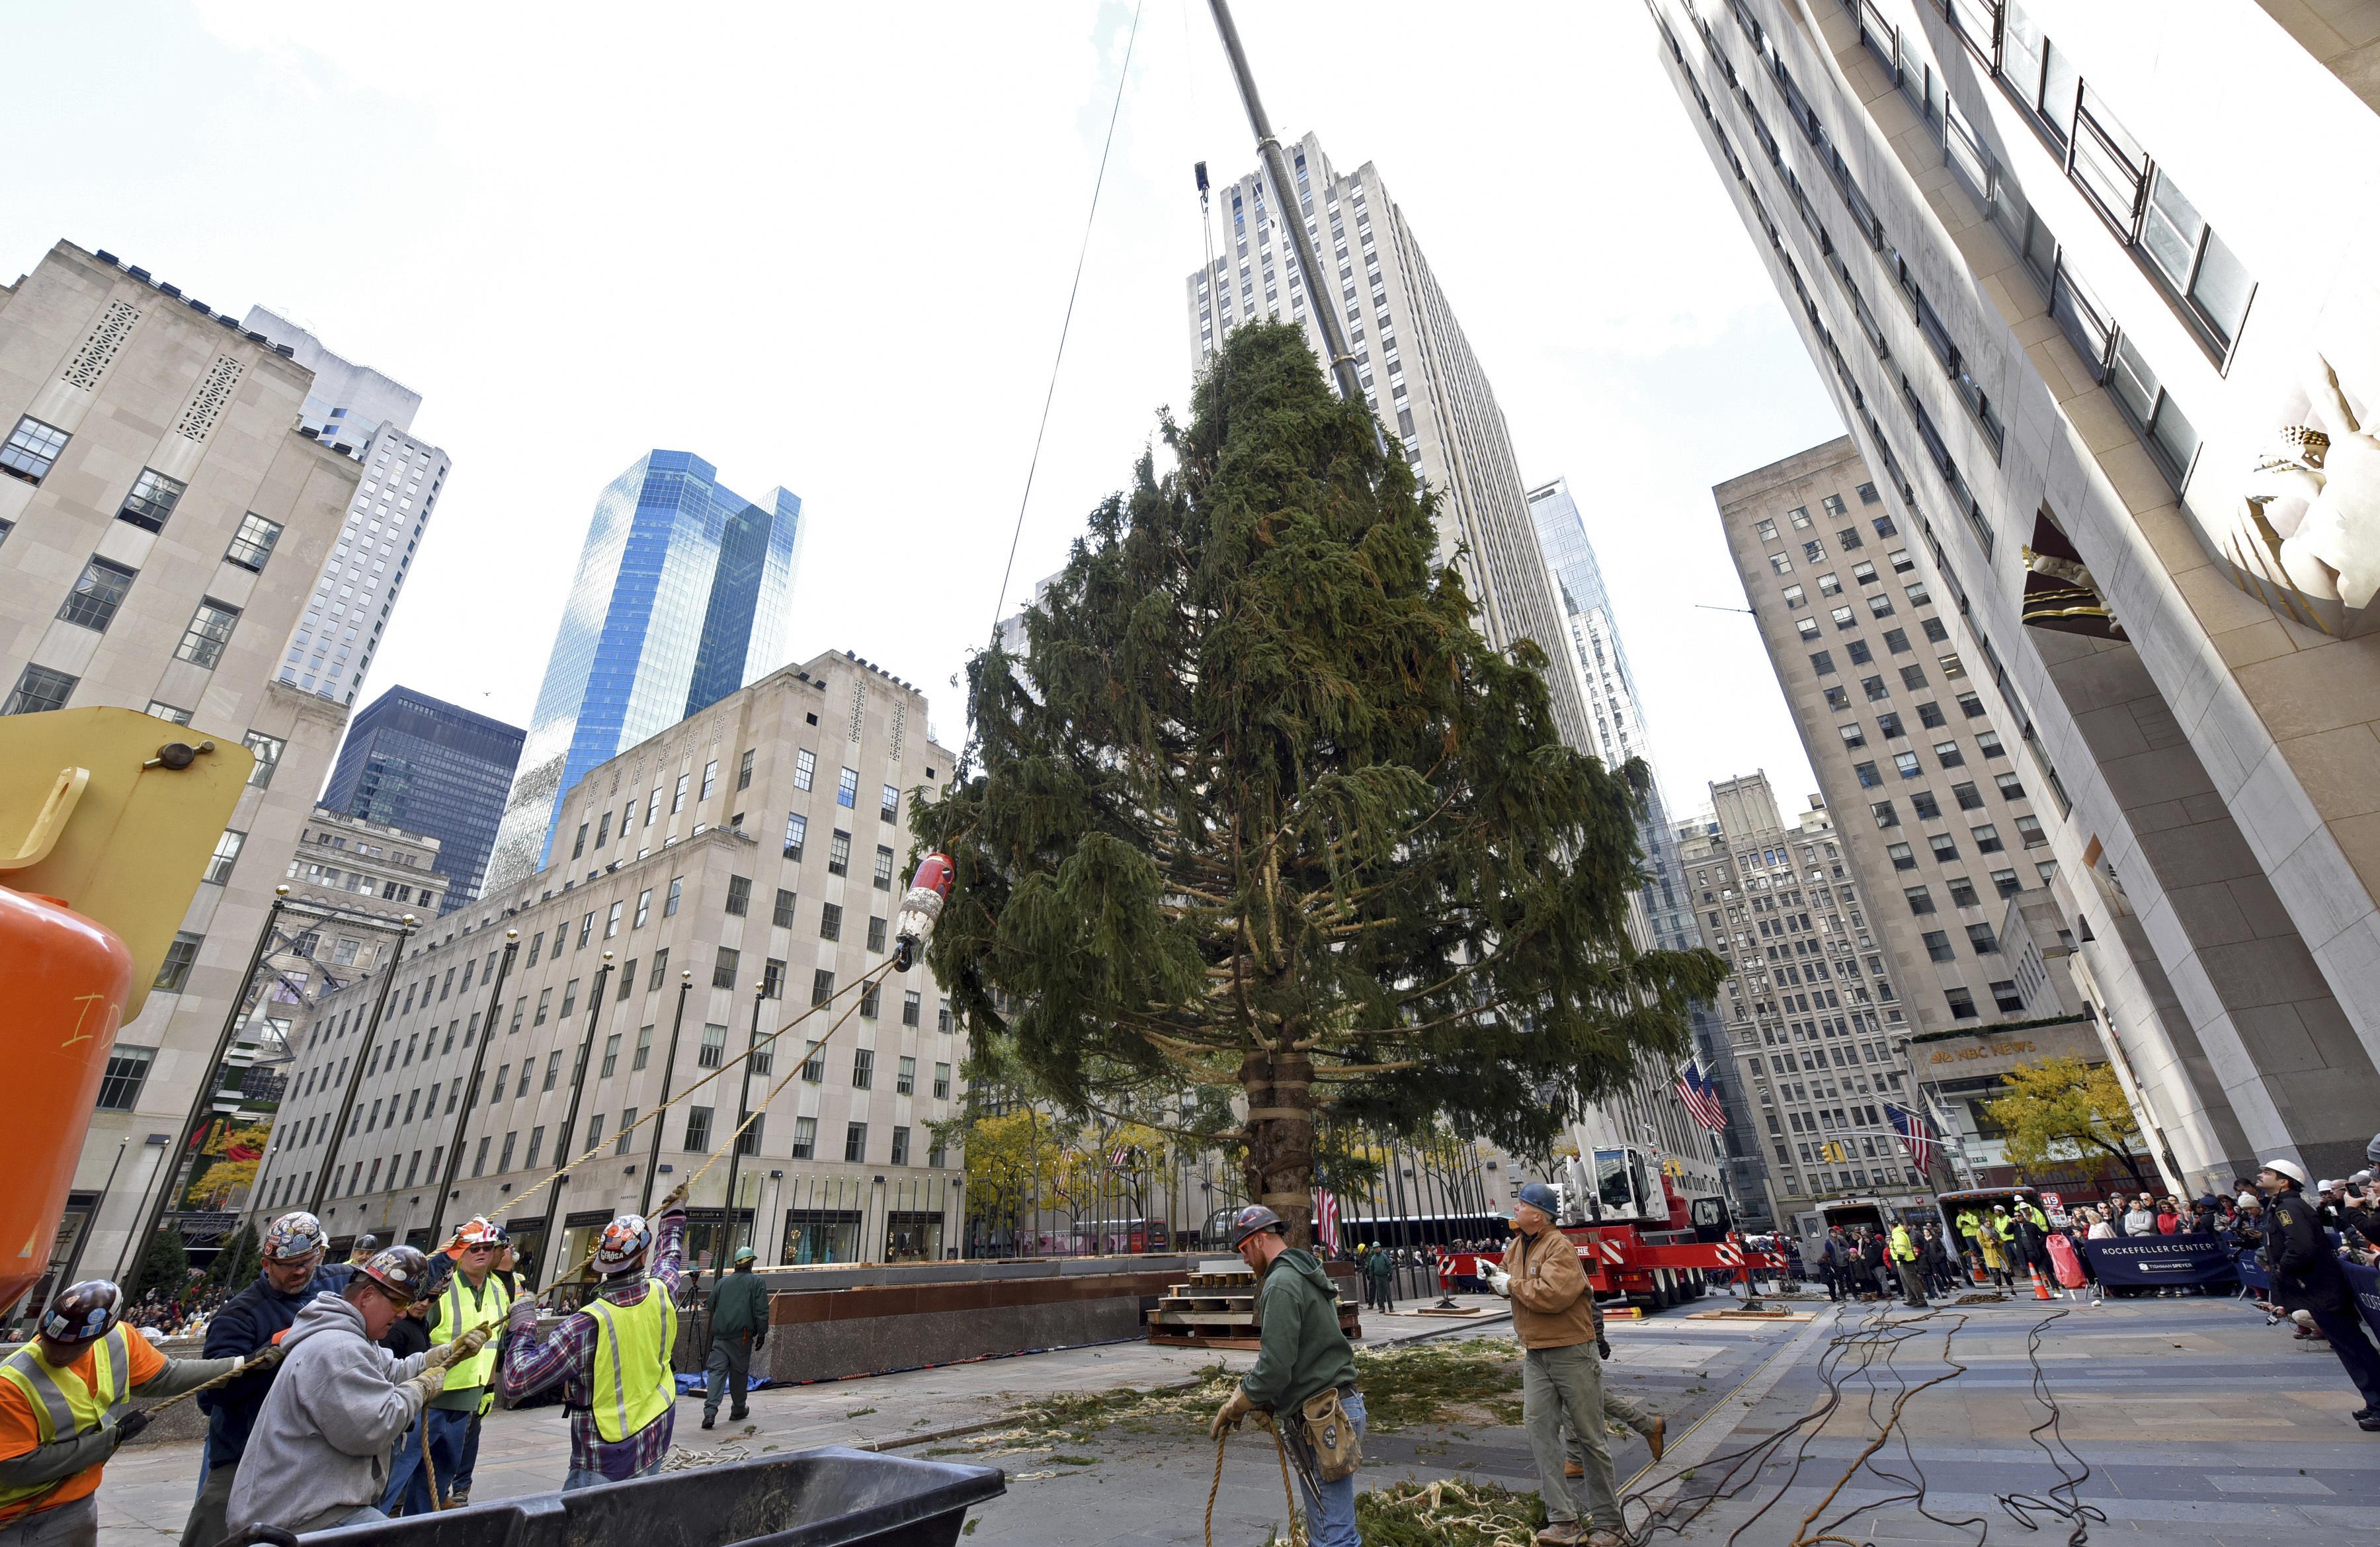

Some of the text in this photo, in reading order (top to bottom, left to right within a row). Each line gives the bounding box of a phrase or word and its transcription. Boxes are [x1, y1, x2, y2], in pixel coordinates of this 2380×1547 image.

[1954, 1040, 2037, 1062] NBC NEWS
[2043, 1196, 2059, 1204] $19
[600, 1249, 624, 1261] GEROSA
[2102, 1245, 2170, 1255] ROCKEFELLER
